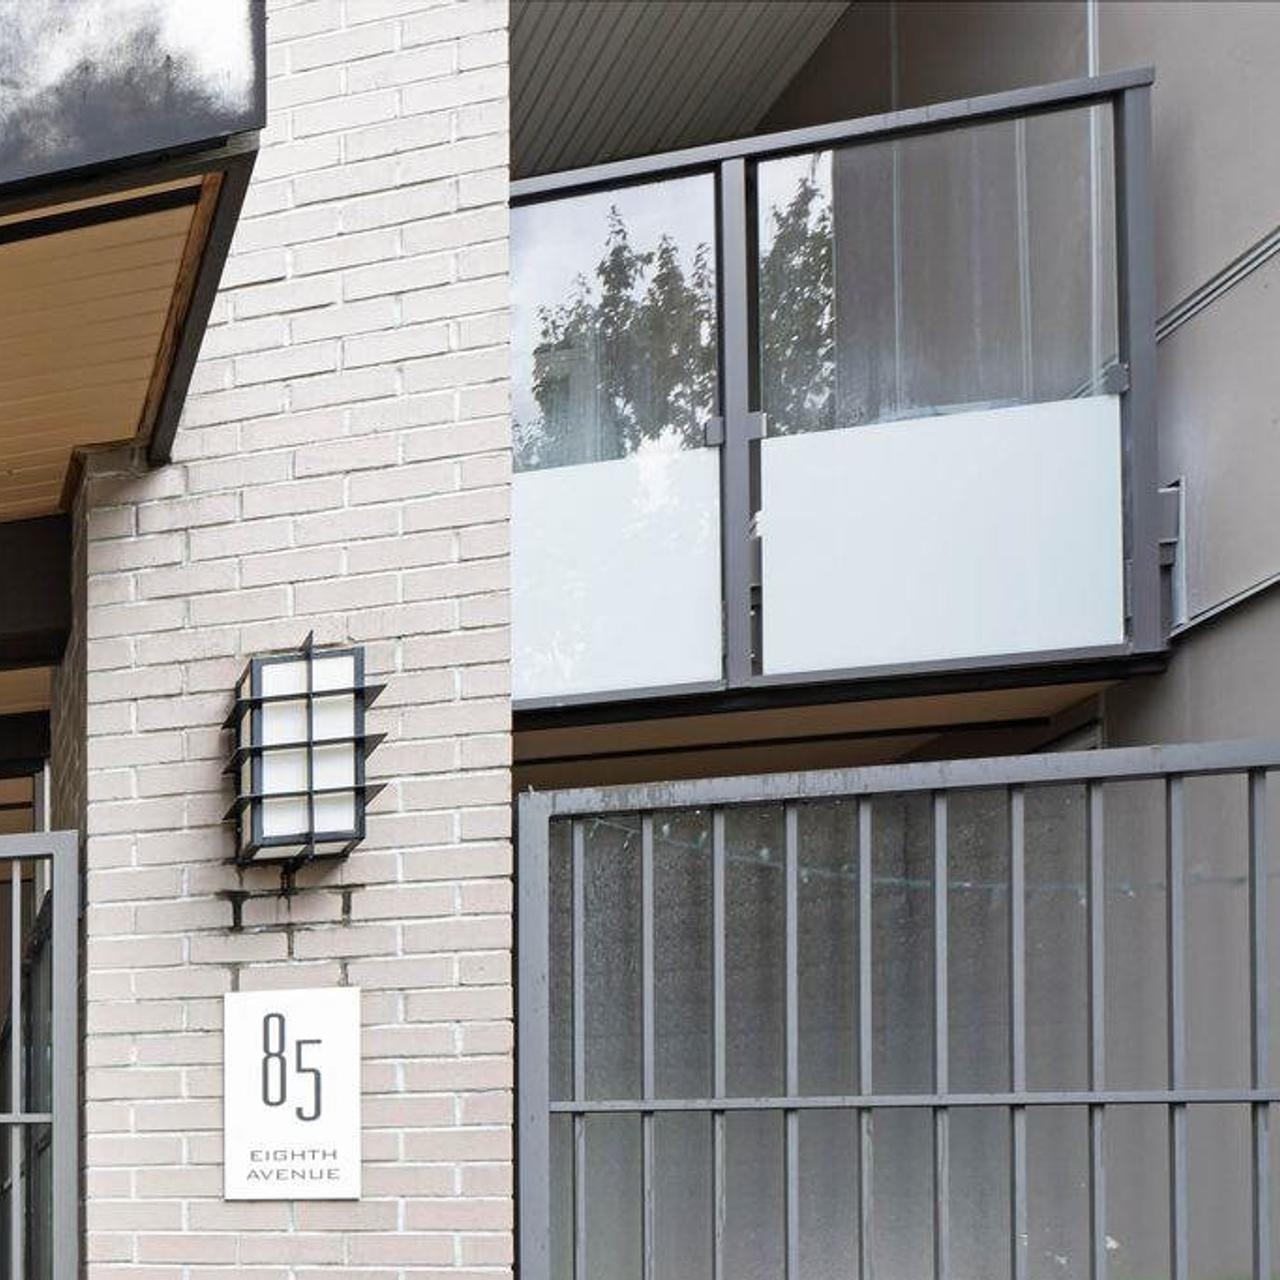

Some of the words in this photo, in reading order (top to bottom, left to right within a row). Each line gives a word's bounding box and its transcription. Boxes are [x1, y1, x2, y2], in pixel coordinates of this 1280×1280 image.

[262, 1013, 322, 1121] 85
[250, 1149, 338, 1162] EIGHTH
[246, 1168, 341, 1181] AVENUE
